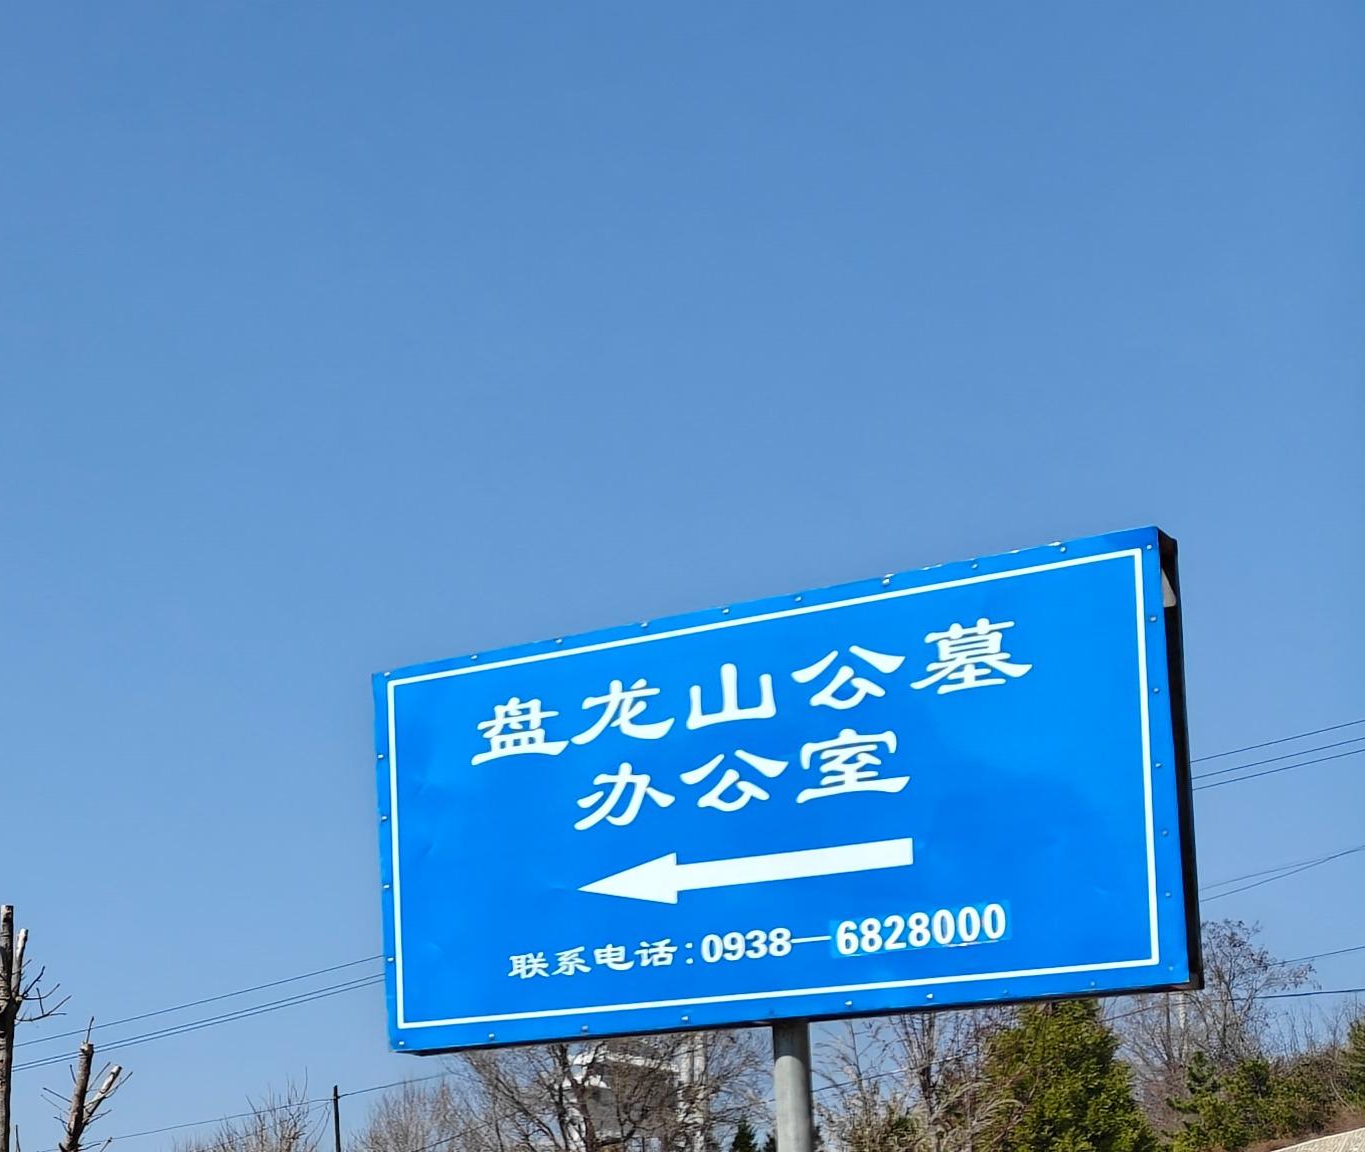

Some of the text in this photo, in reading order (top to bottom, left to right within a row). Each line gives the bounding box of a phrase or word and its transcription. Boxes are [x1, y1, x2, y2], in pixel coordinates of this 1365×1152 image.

[471, 617, 1033, 766] 盘龙山公墓
[574, 728, 911, 831] 办公室
